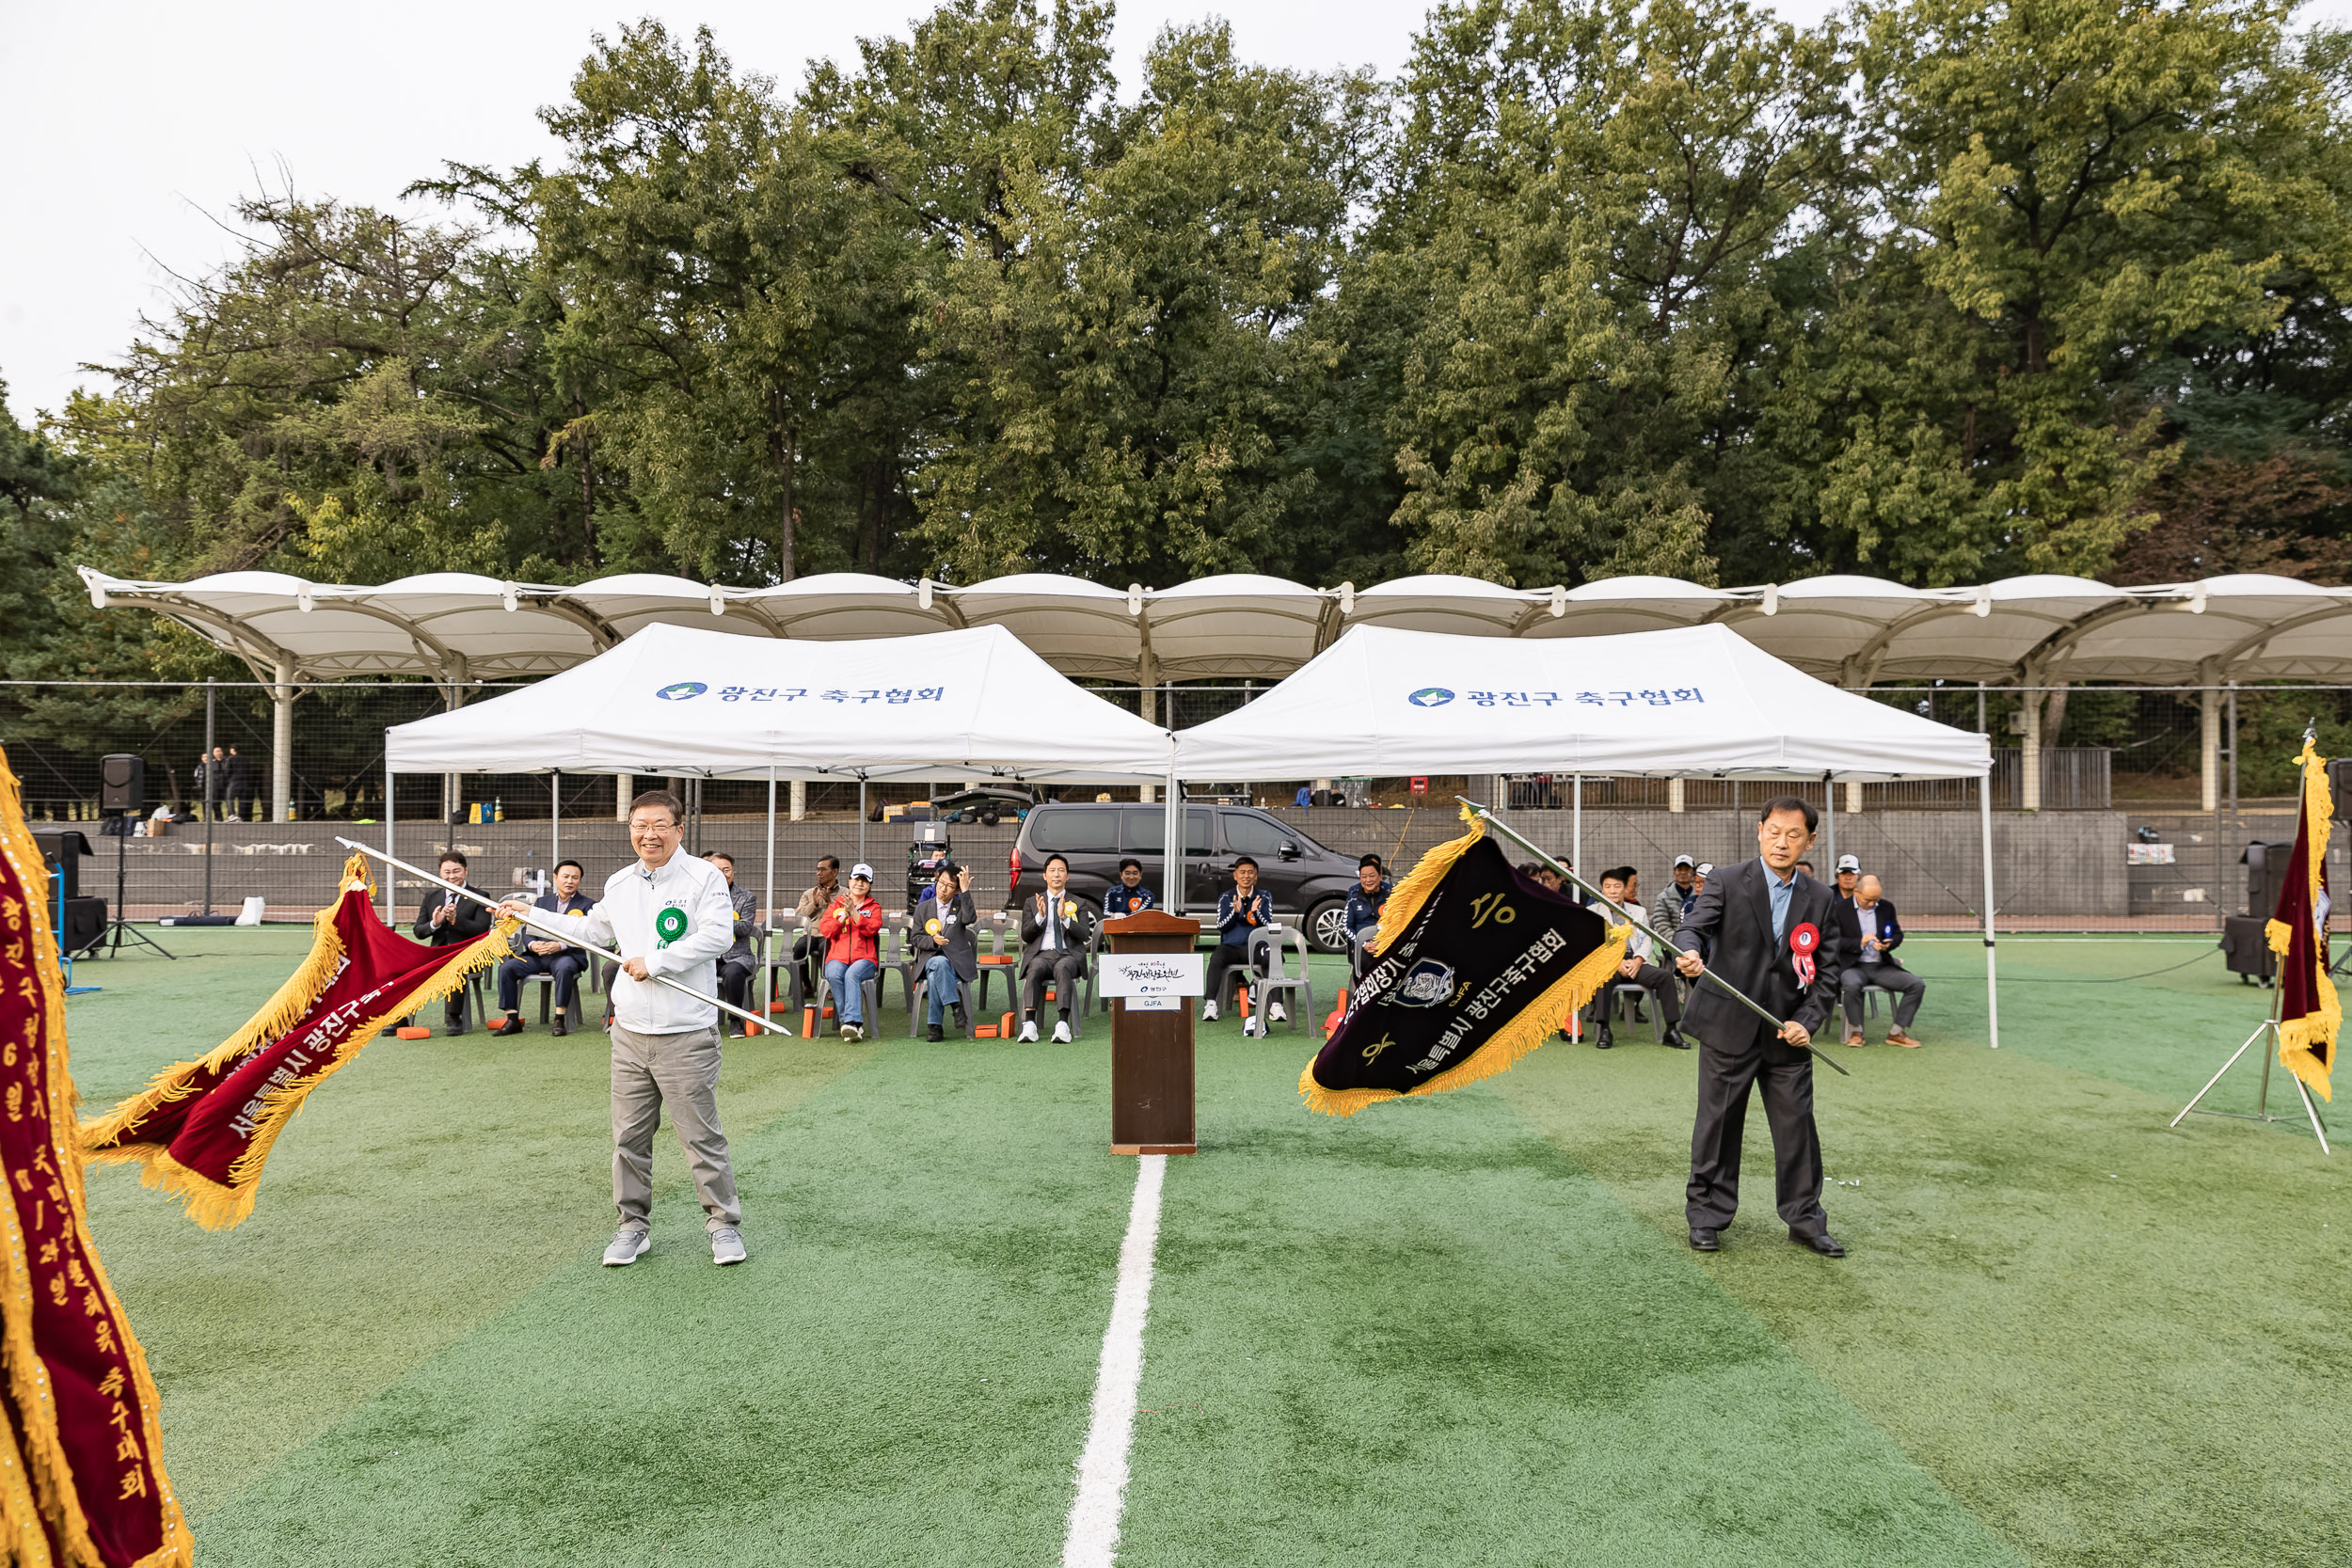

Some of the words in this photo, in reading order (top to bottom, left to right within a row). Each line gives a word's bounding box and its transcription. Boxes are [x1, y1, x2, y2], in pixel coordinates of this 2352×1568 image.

[717, 687, 807, 702] 광진구
[820, 687, 944, 704] 축구협회
[1468, 690, 1563, 706] 광진구
[1575, 688, 1704, 707] 축구협회
[1406, 1016, 1473, 1074] 서울특별시
[1465, 927, 1567, 1020] 광진구축구협회
[1449, 981, 1472, 1007] GJFA
